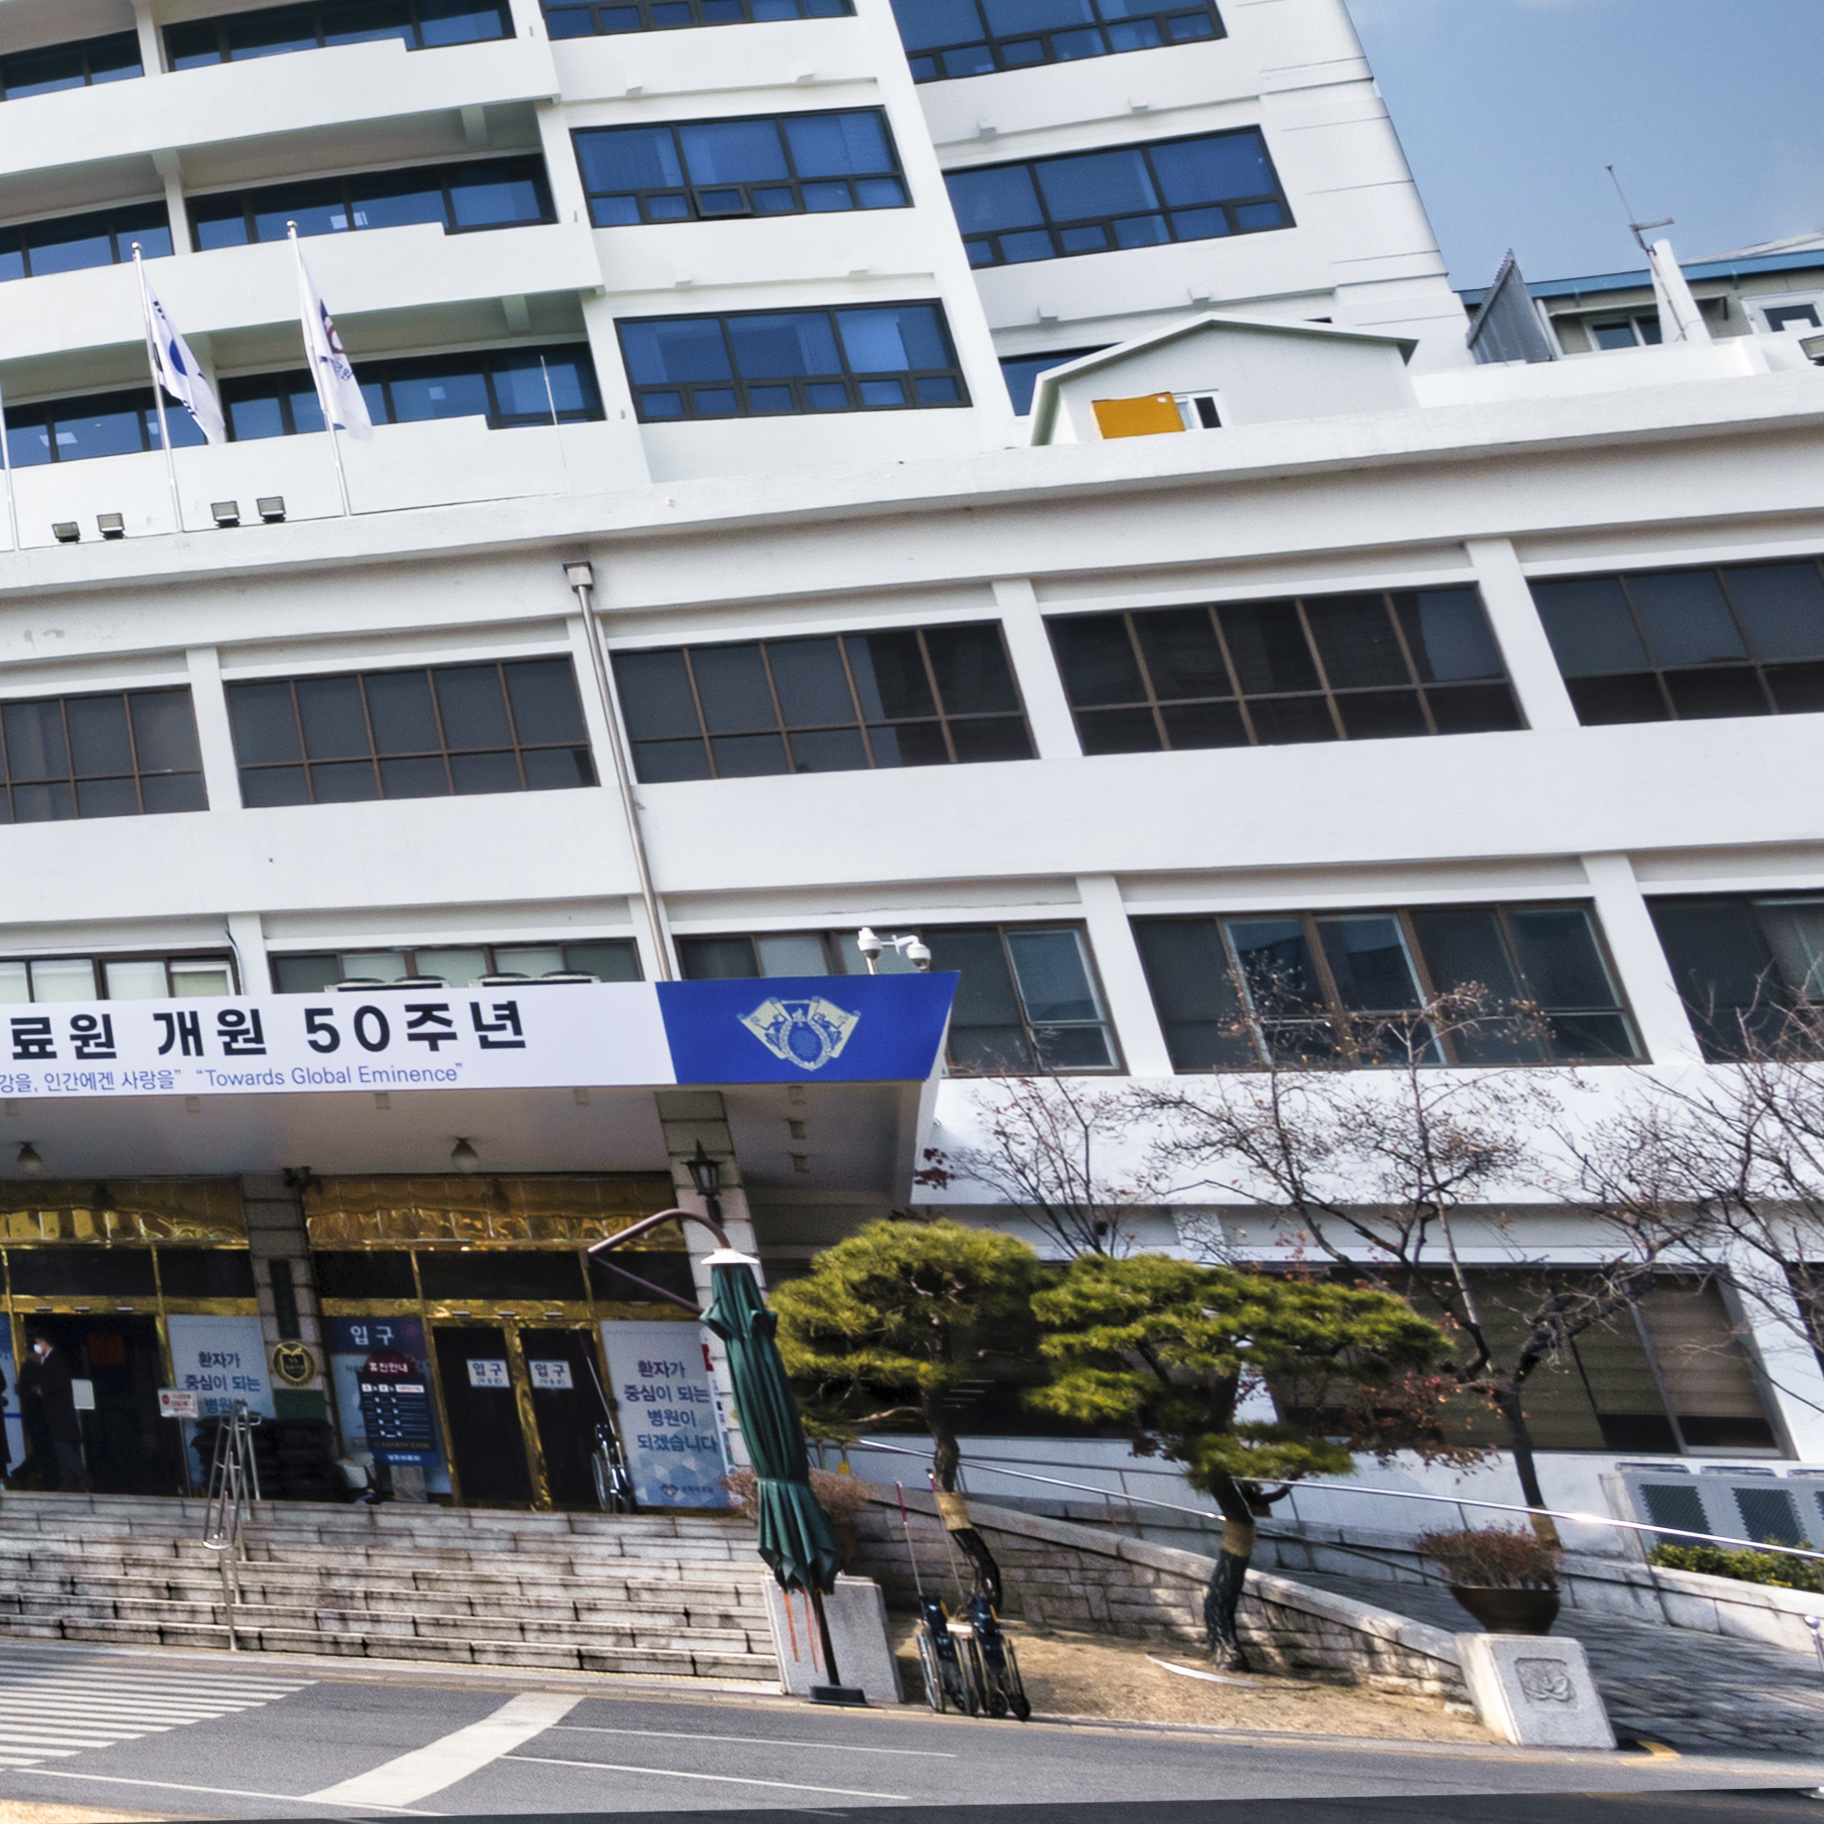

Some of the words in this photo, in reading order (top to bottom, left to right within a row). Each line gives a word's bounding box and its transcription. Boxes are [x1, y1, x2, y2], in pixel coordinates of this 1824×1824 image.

[153, 1008, 267, 1057] 개원
[304, 1000, 526, 1054] 50주년
[44, 1071, 115, 1092] 인간에겐
[292, 1066, 352, 1085] Global
[198, 1351, 241, 1368] 환자가
[638, 1360, 686, 1378] 환자가
[185, 1374, 228, 1392] 중심이
[232, 1376, 261, 1392] 되는
[624, 1384, 673, 1403] 중심이
[677, 1385, 710, 1403] 되는
[647, 1409, 696, 1427] 병원이
[637, 1434, 718, 1453] 되겠습니다
